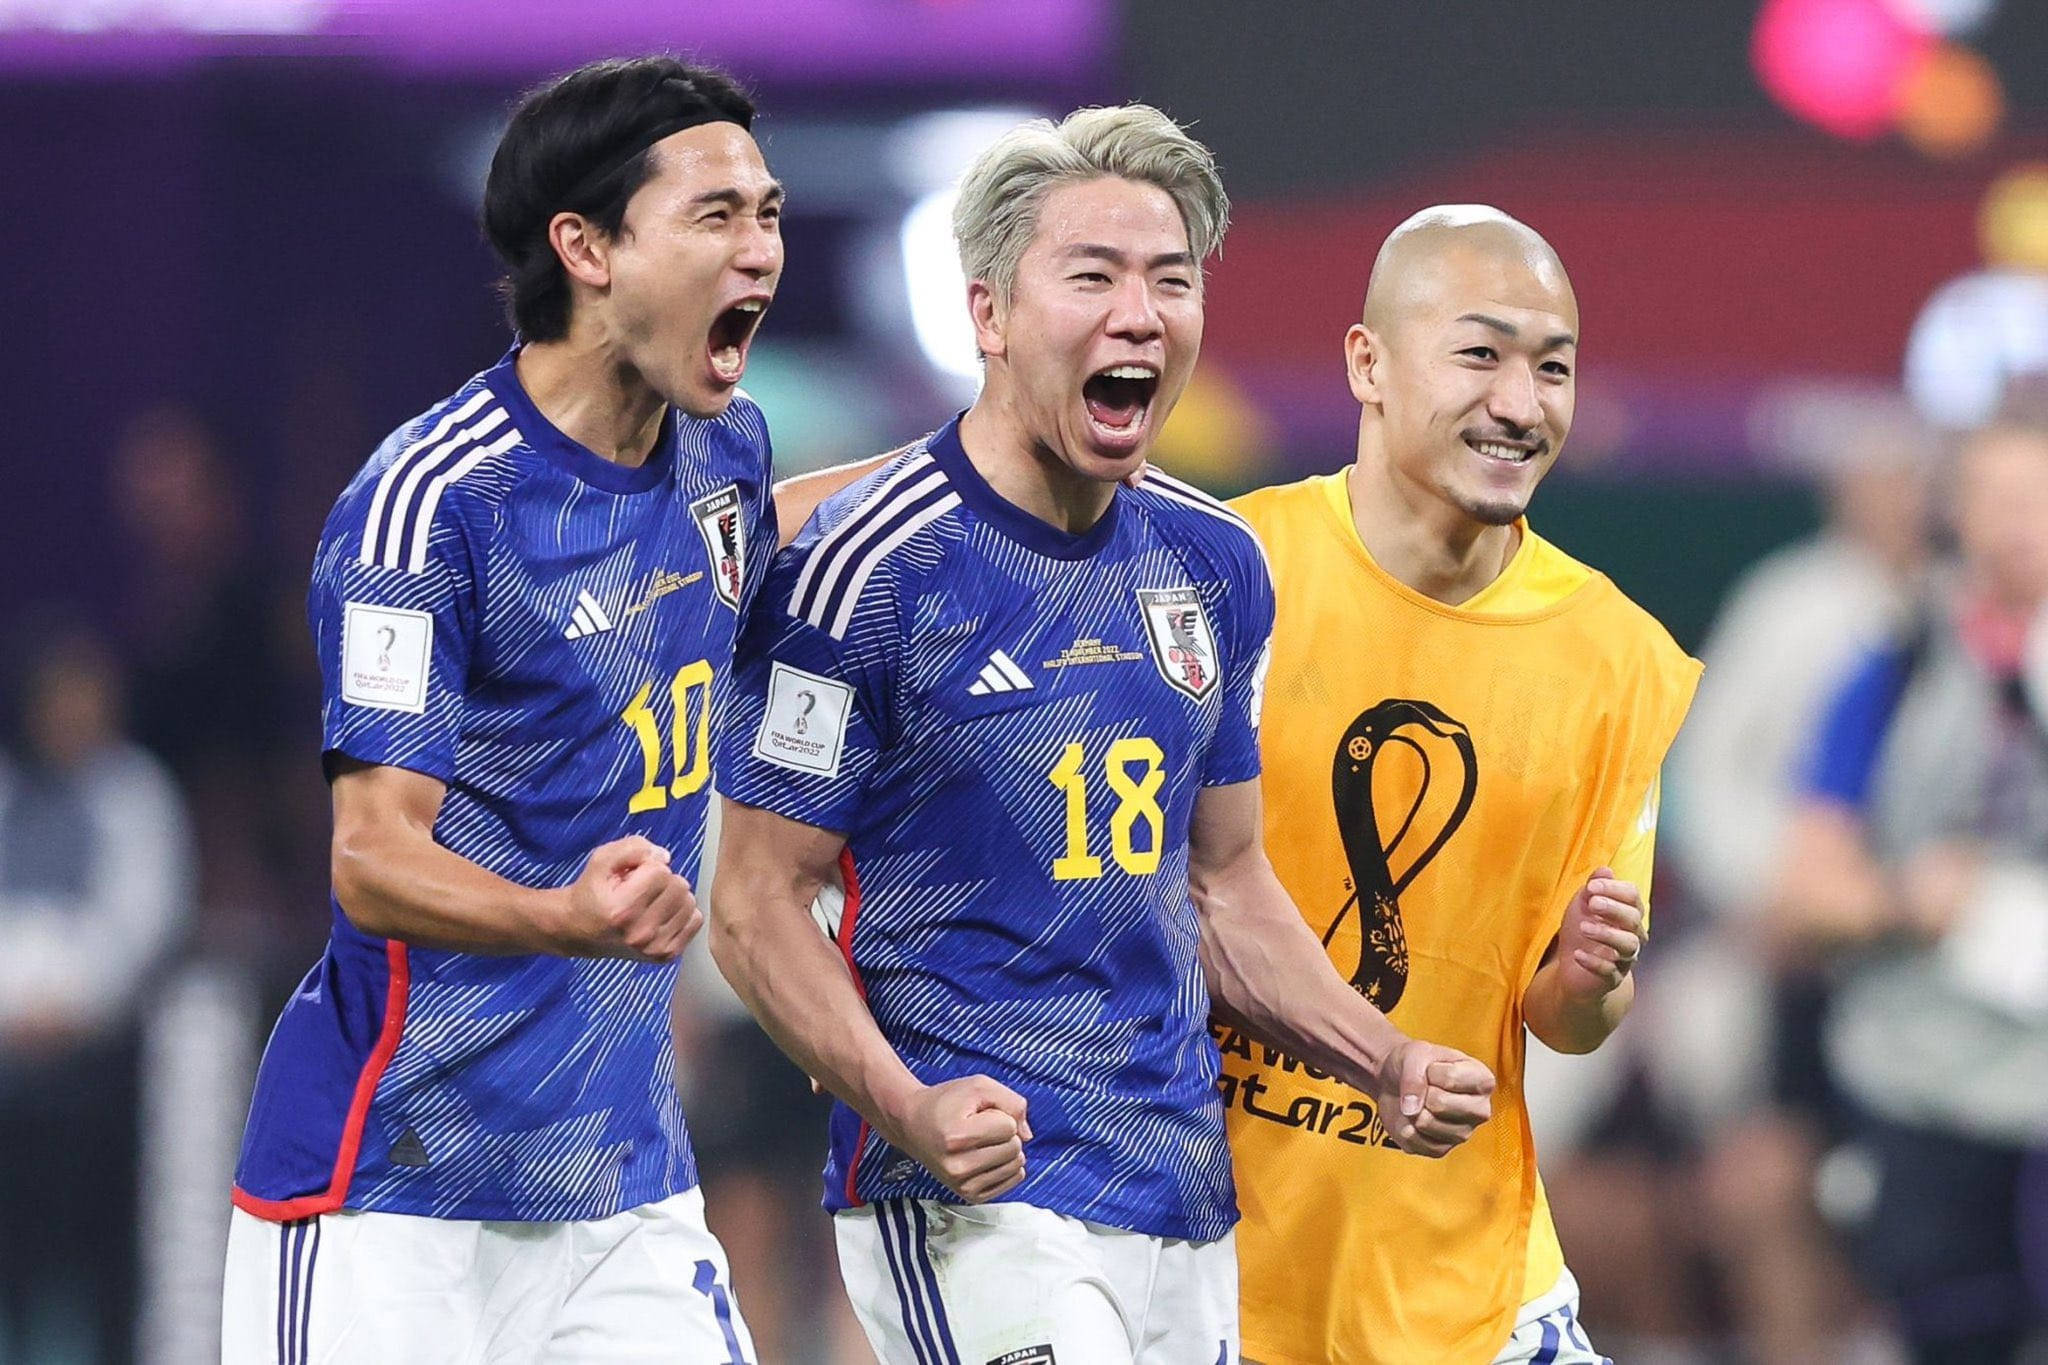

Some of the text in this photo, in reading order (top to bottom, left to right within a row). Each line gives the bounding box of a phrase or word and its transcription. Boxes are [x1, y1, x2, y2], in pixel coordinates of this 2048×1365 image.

[706, 495, 731, 512] JAPAN
[1153, 592, 1187, 603] JAPAN
[621, 659, 714, 814] 10
[771, 731, 784, 739] FIFA
[785, 736, 810, 746] WORLD
[1049, 737, 1165, 881] 18
[1001, 1347, 1038, 1365] JAPAN
